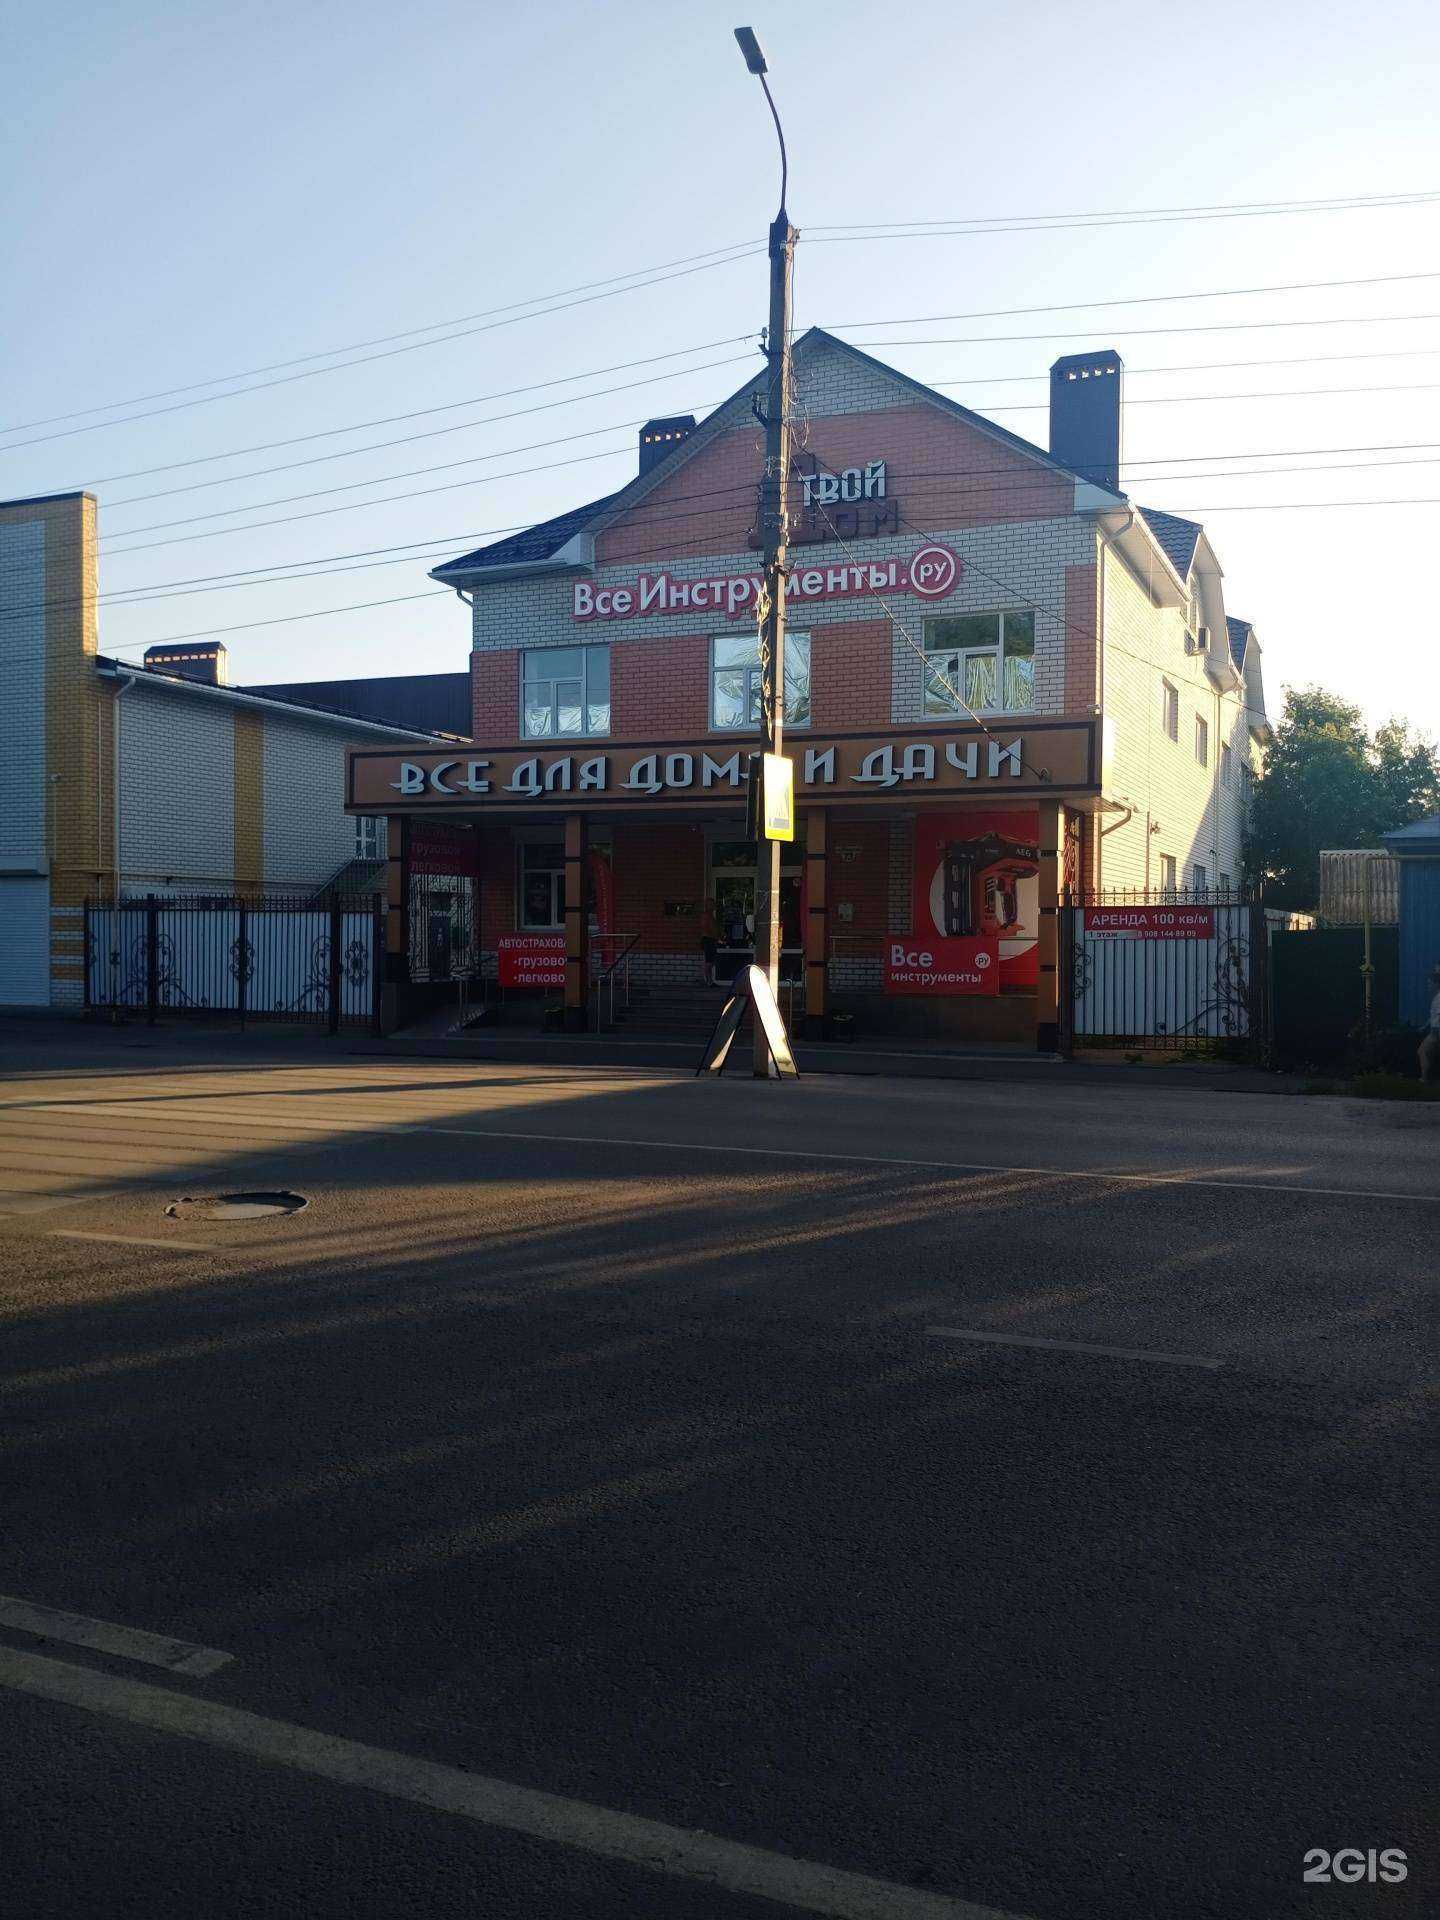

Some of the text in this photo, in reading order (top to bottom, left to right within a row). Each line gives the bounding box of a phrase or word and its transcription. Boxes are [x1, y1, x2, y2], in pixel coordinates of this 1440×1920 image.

[799, 459, 887, 507] ТВОЙ
[573, 582, 631, 617] Все
[389, 736, 1022, 797] ВСЕ ДЛЯ ДОМ И ДАЧИ
[1091, 912, 1208, 927] АРЕНДА 100 кв/м
[891, 944, 933, 968] Все
[518, 973, 566, 984] легково
[890, 972, 983, 986] инструменты
